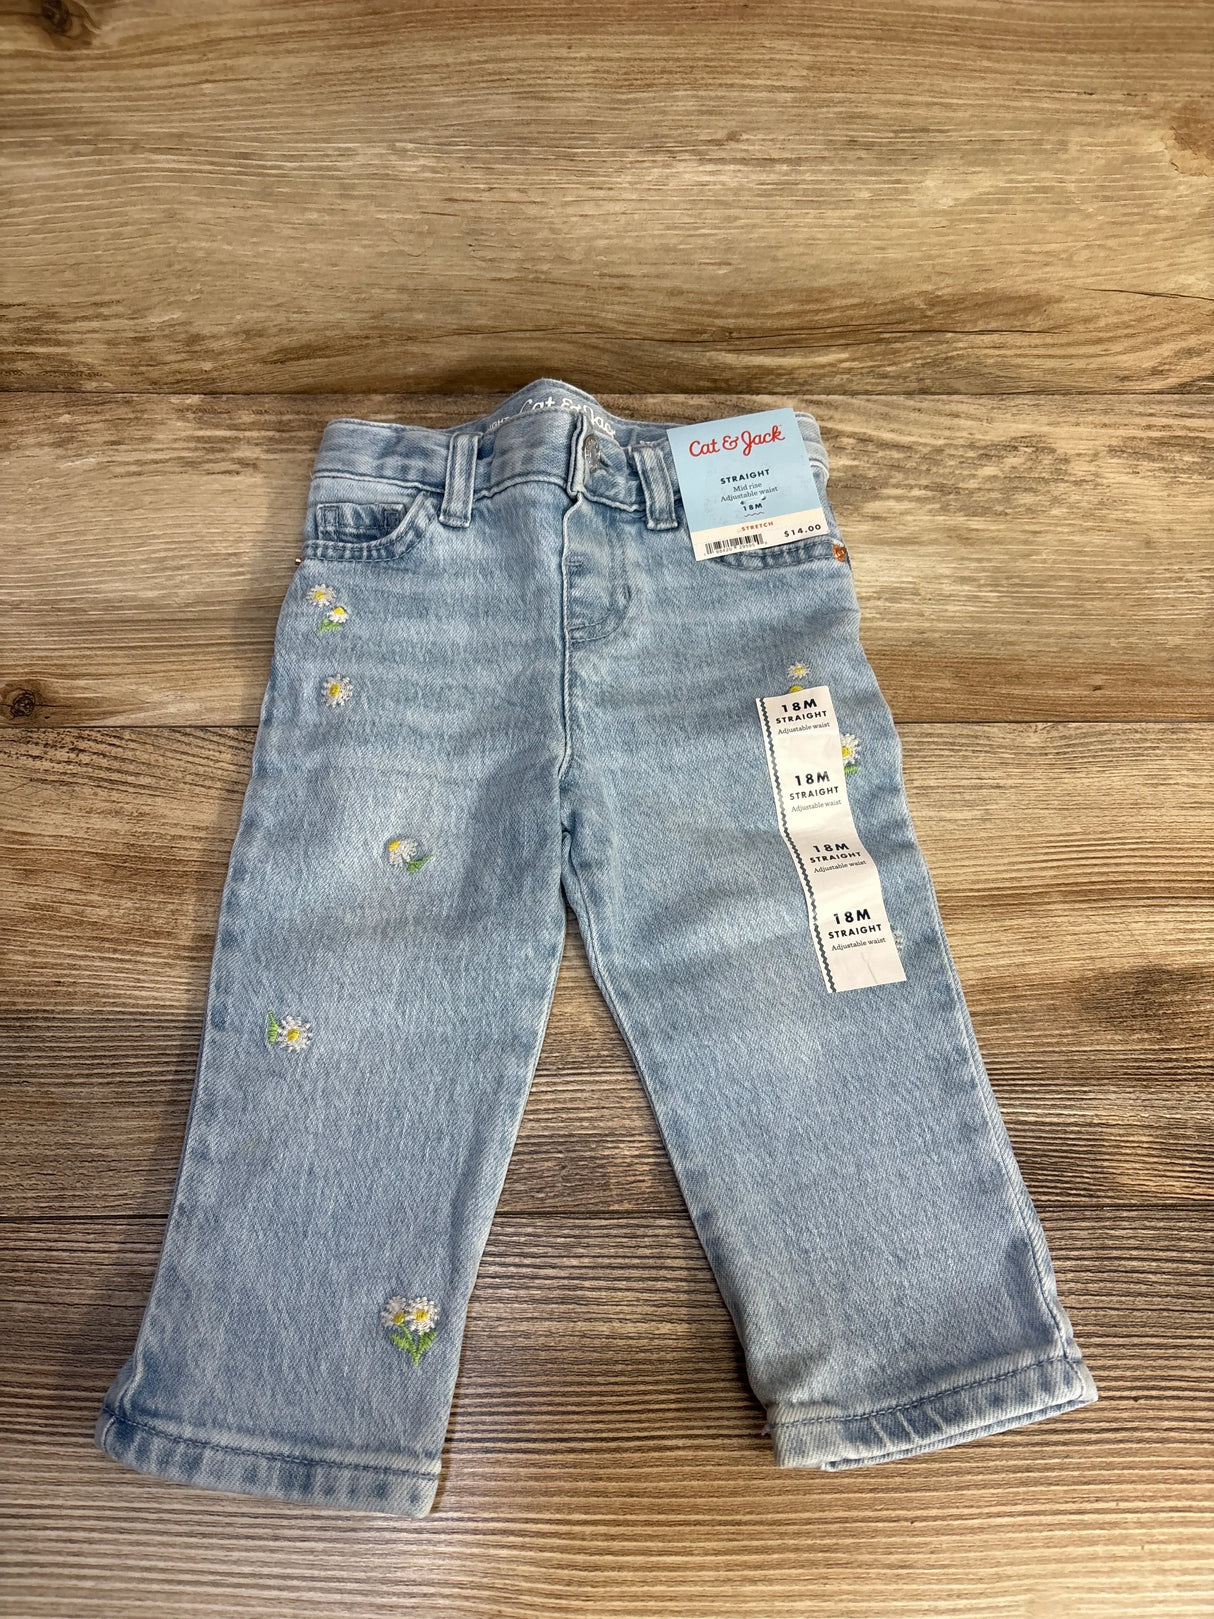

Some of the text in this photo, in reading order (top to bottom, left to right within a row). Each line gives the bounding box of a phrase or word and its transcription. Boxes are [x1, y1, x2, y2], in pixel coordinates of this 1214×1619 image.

[688, 424, 786, 457] Cat & Jack
[720, 468, 771, 485] STRAIGHT
[720, 485, 779, 503] Adjustable waist
[733, 481, 763, 493] Mid rise
[742, 502, 763, 512] 18M
[741, 521, 774, 532] STRETCH
[783, 523, 822, 538] $14.00
[781, 698, 818, 713] 18M
[775, 710, 828, 725] STRAIGHT
[777, 721, 831, 736] Adjustable waist
[794, 770, 831, 787] 18M
[789, 786, 840, 801] STRAIGHT
[791, 799, 842, 813] Adjustable waist
[812, 842, 850, 853] 18M
[809, 851, 862, 864] STRAIGHT
[813, 859, 867, 874] Adjustable waist
[833, 908, 871, 925] 18M
[828, 923, 882, 940] STRAIGHT
[831, 937, 887, 952] Adjustable waist
